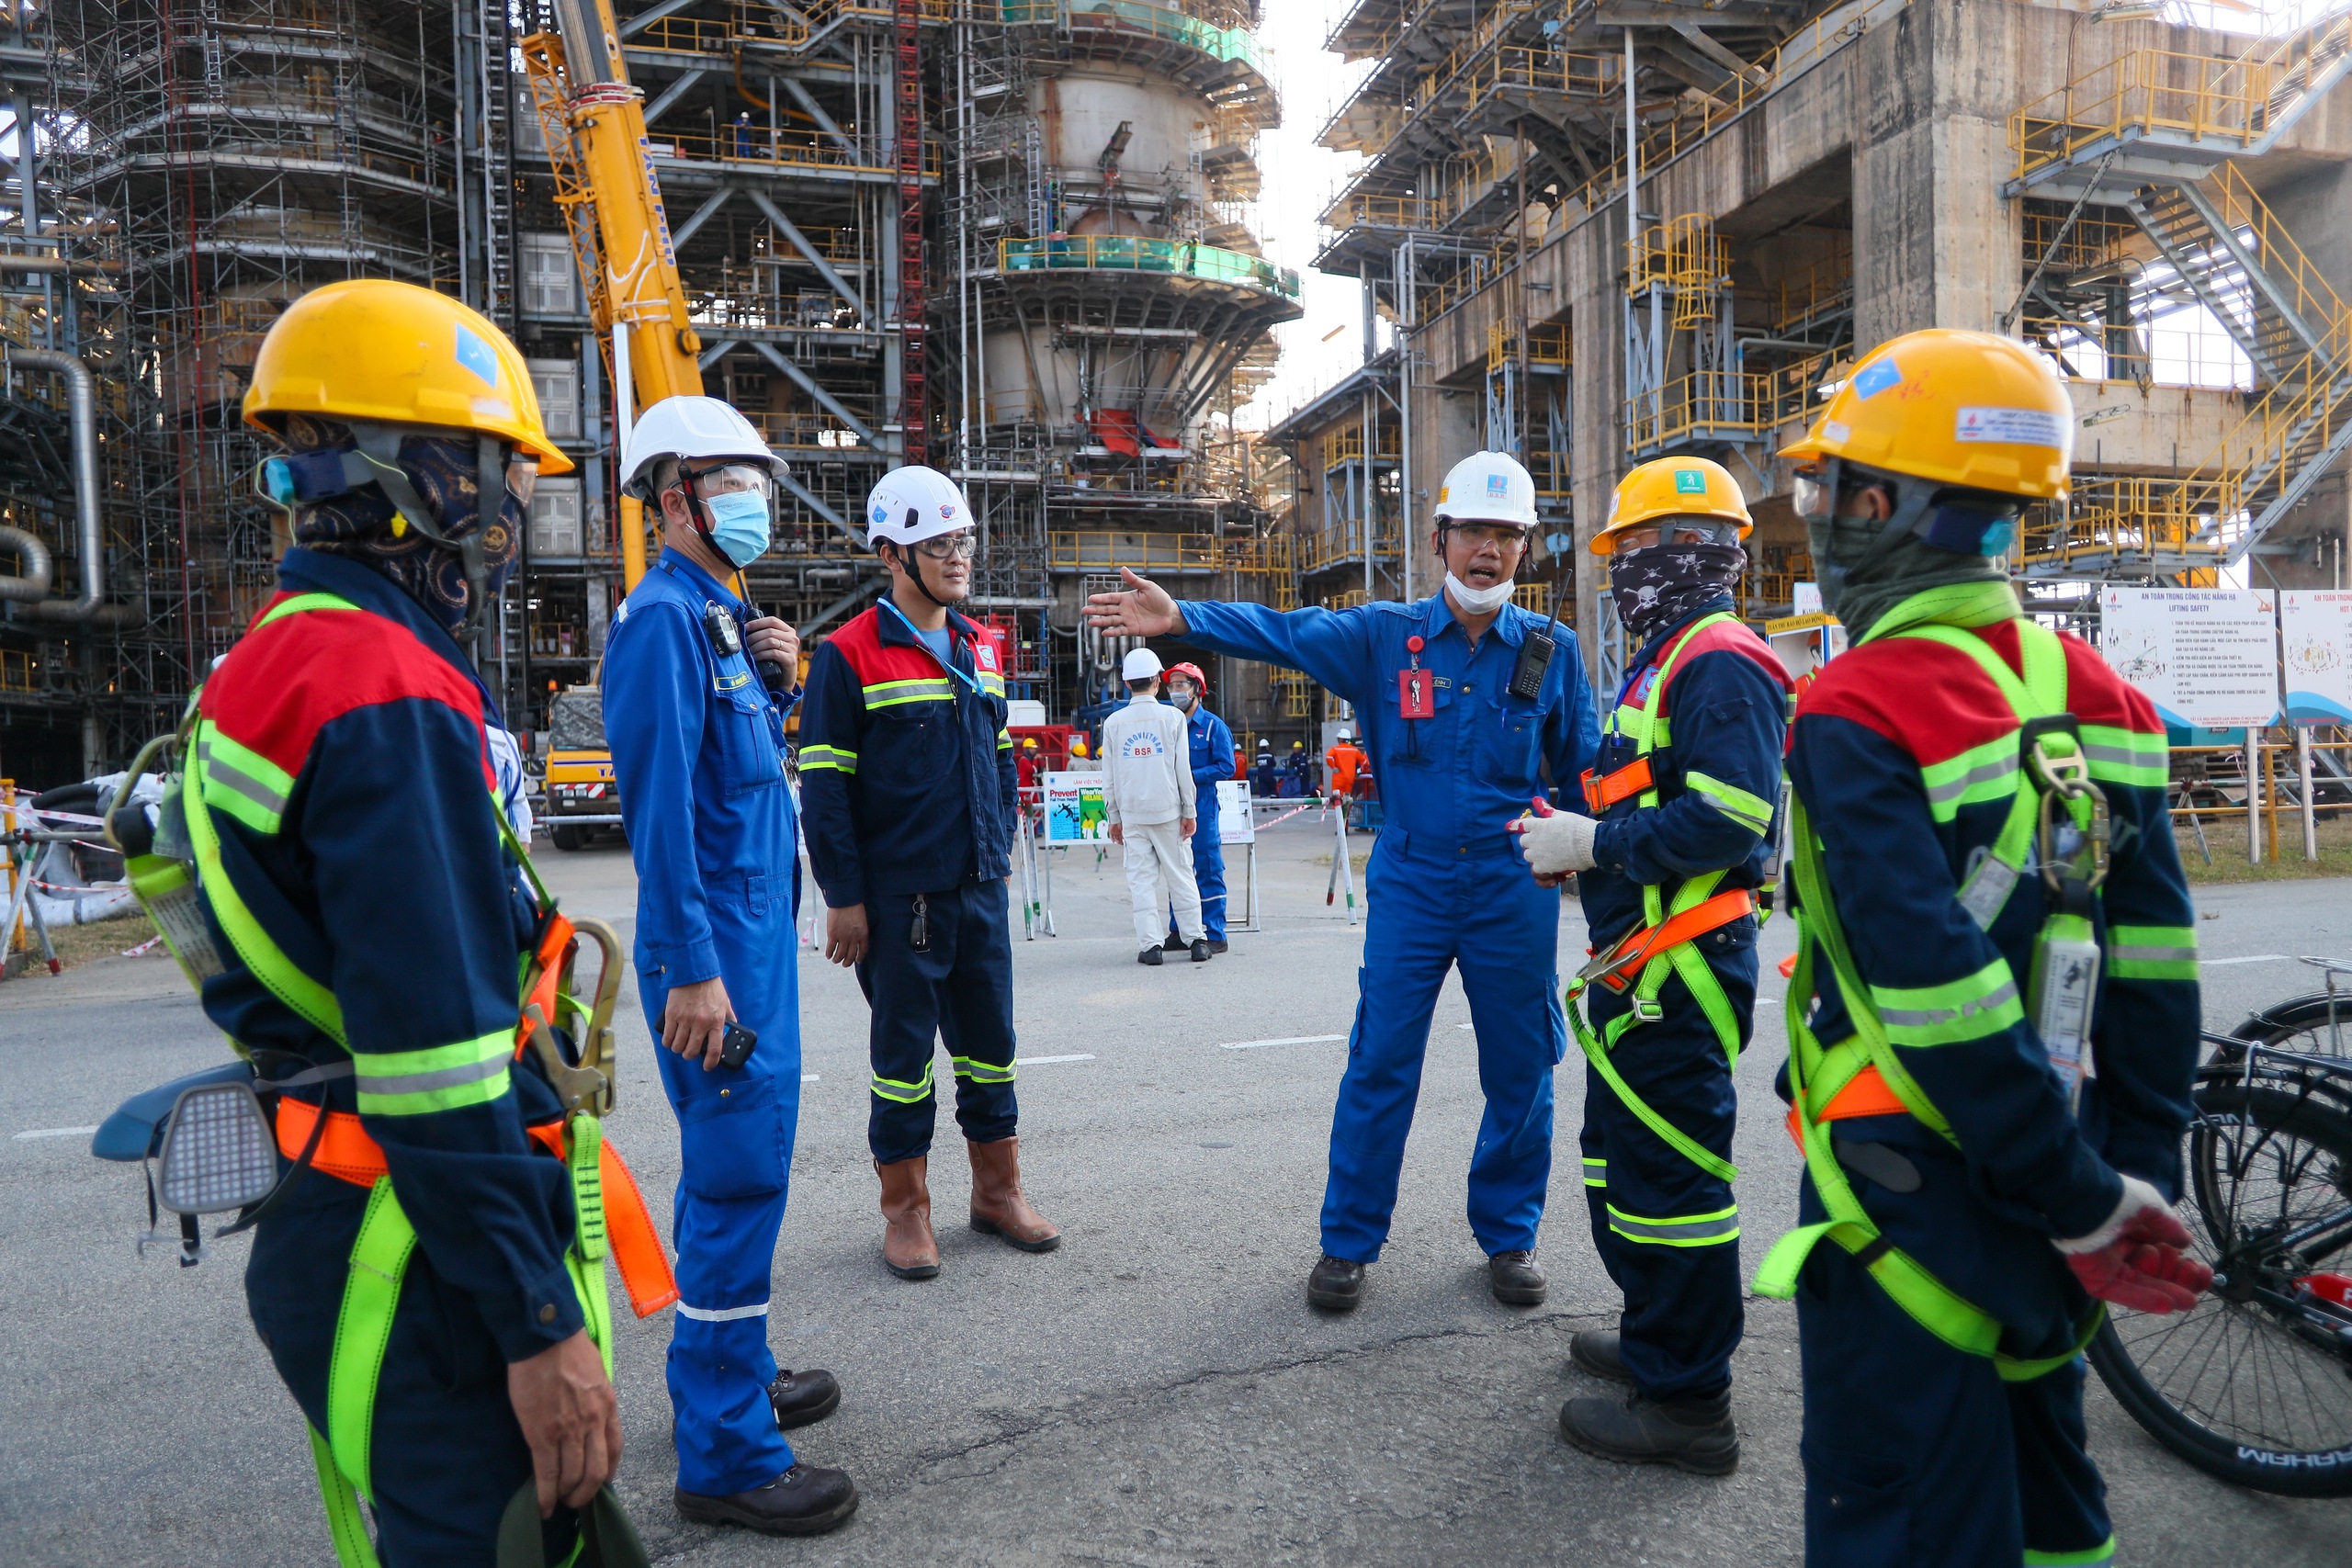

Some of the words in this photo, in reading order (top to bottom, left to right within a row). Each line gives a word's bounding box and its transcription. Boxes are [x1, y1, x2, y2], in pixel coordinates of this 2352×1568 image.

[638, 133, 661, 196] TAN
[1123, 731, 1163, 756] PETROVIETNAM
[2282, 1222, 2322, 1244] abraham
